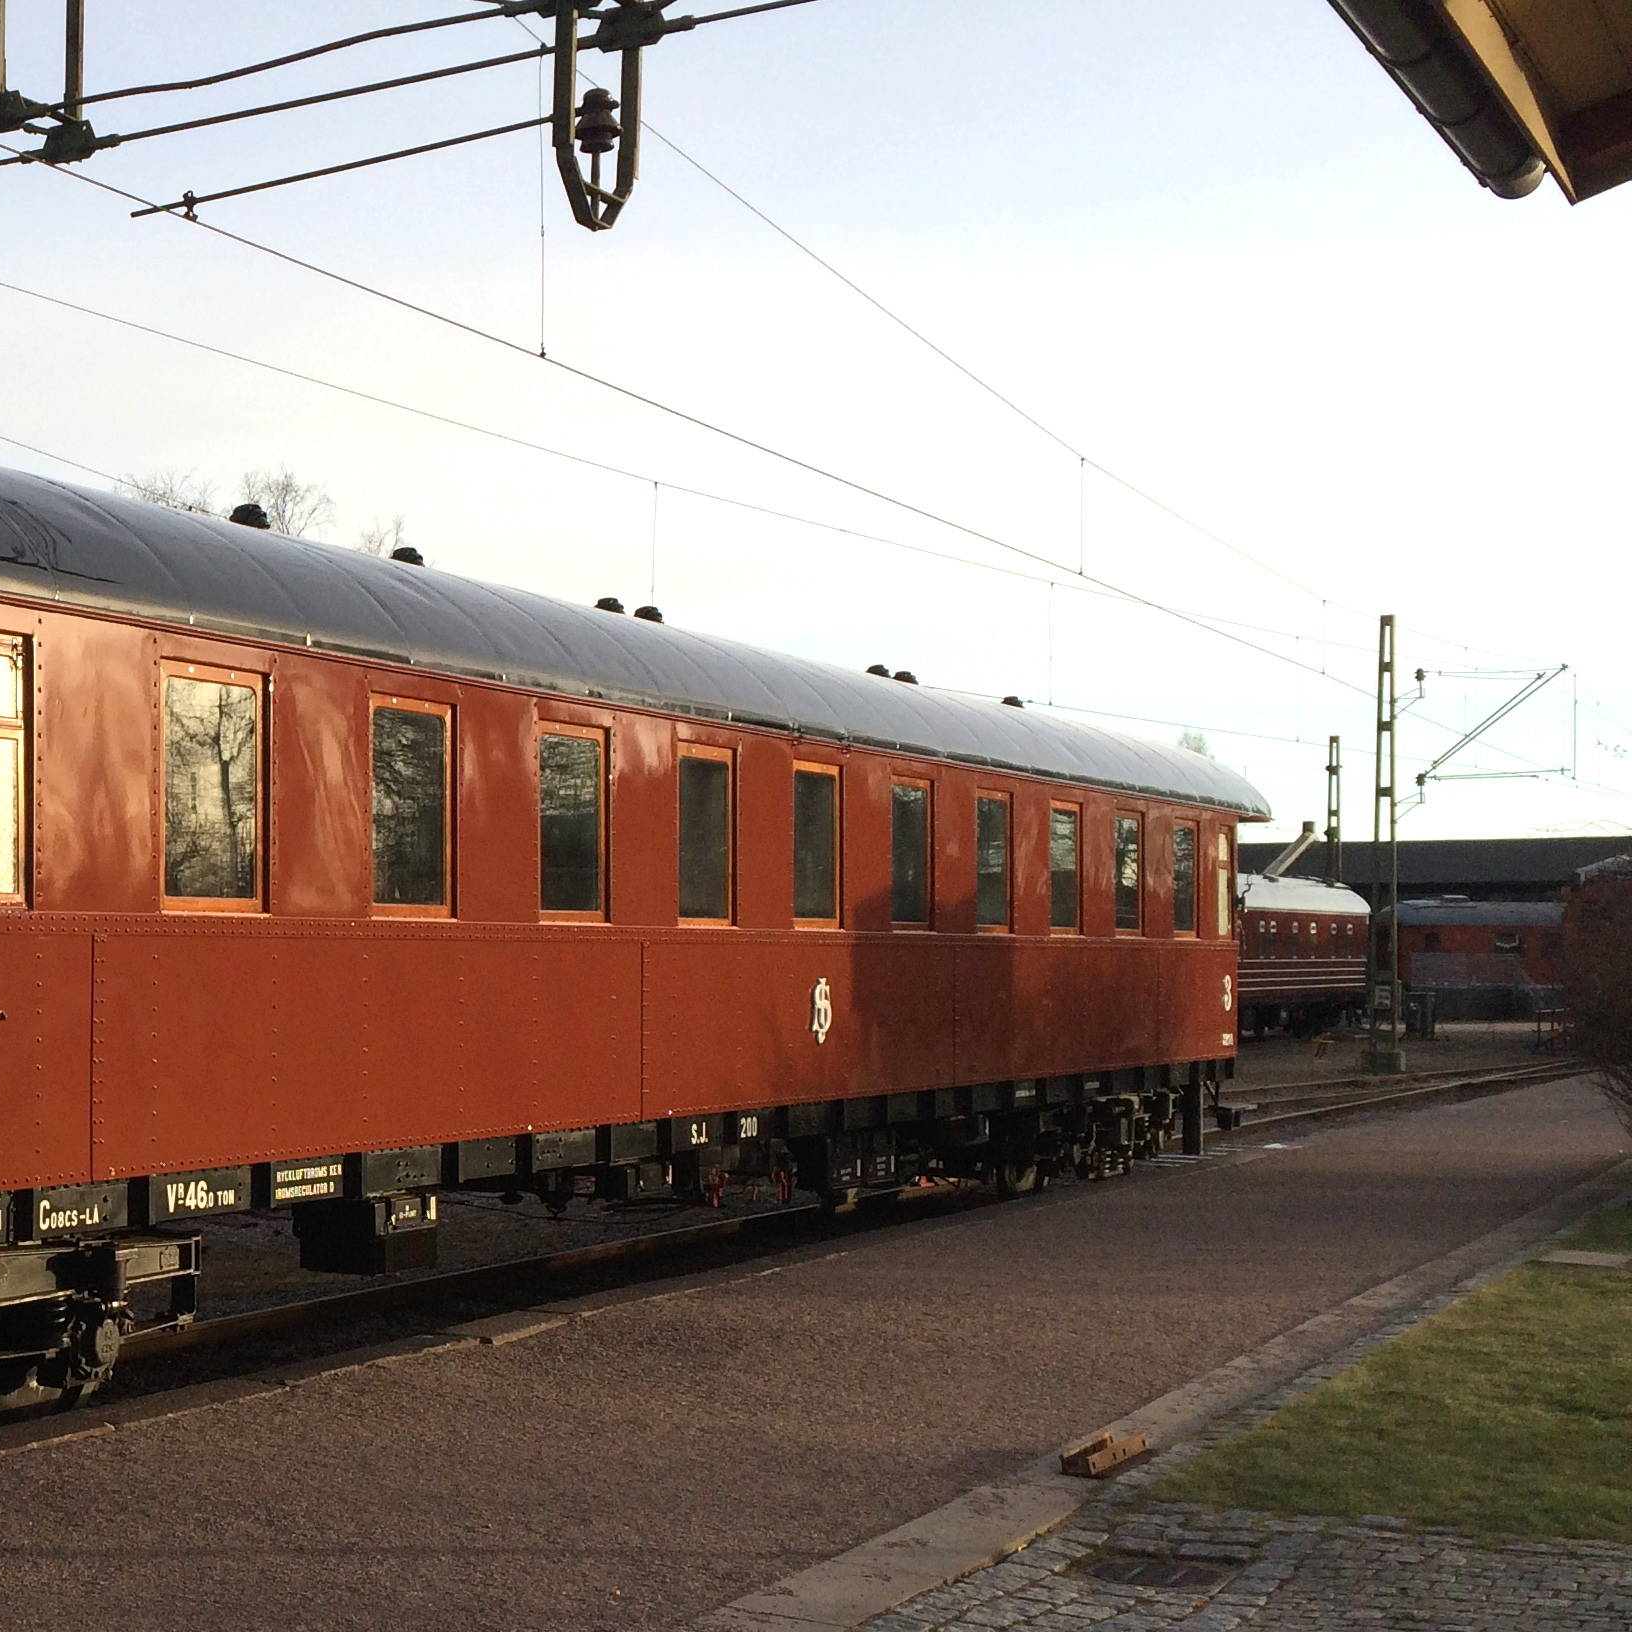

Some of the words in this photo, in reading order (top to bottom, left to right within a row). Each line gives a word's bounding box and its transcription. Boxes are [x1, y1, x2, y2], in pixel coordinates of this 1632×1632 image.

[1222, 974, 1233, 1012] 3
[740, 1116, 758, 1138] 200
[216, 1189, 235, 1206] TON
